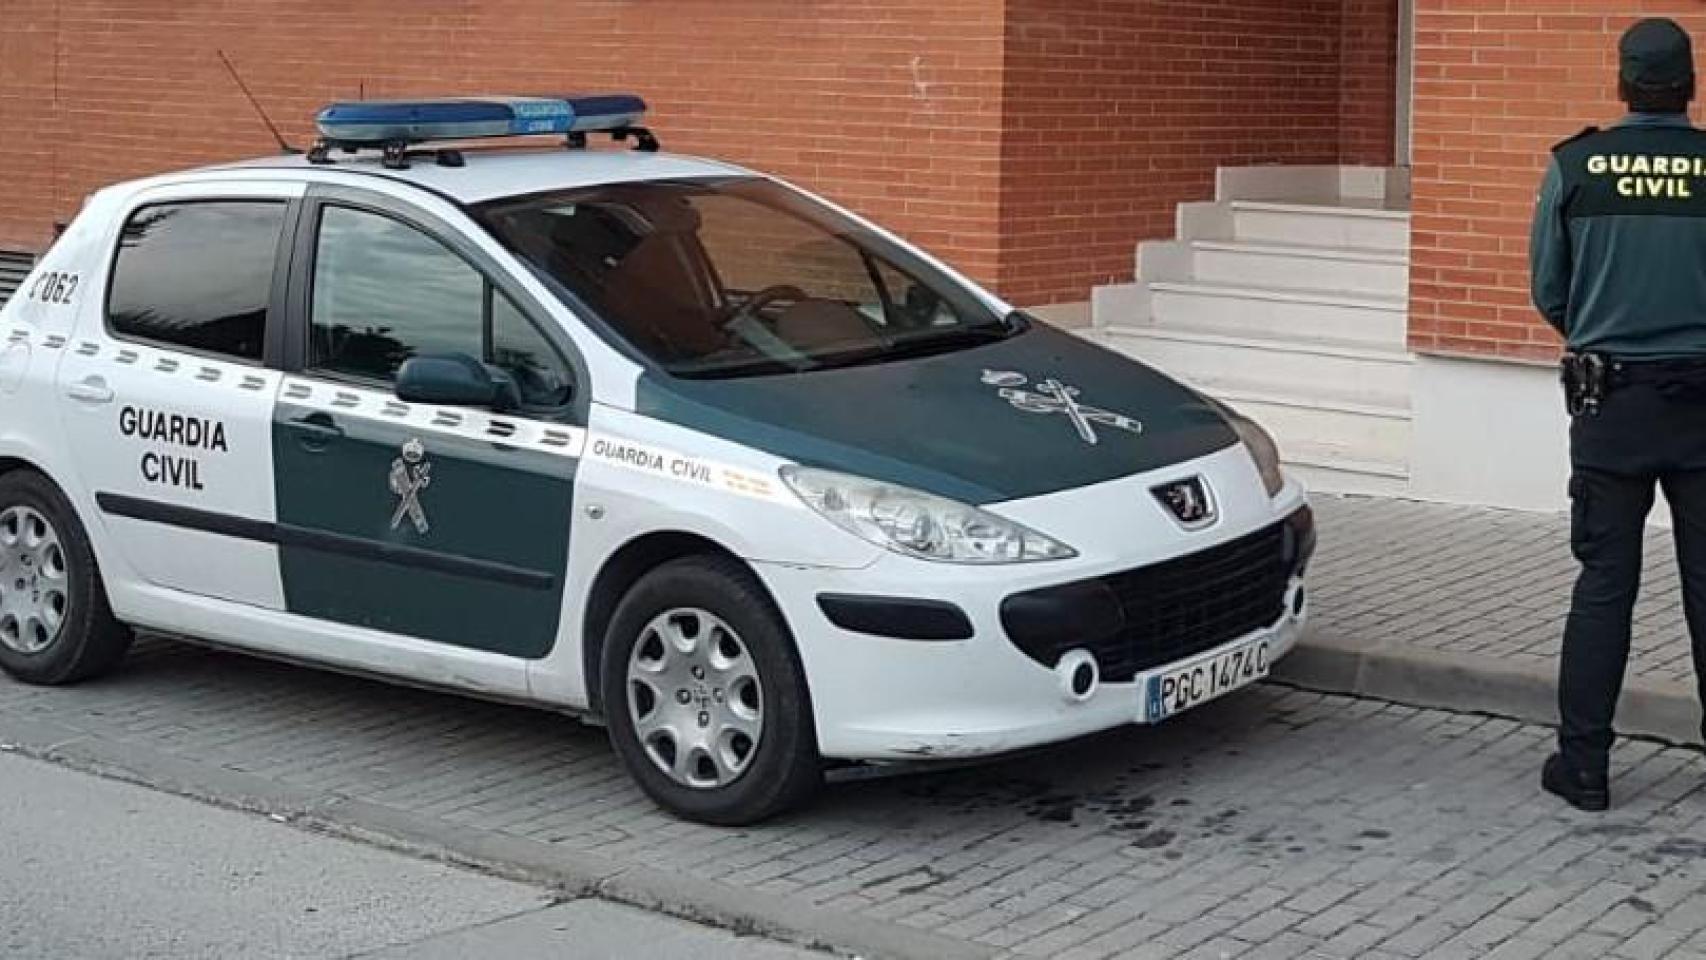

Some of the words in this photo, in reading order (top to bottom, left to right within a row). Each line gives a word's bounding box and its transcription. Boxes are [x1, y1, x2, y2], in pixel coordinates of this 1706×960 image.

[1587, 154, 1706, 176] GUARDI
[1617, 176, 1692, 198] CIVIL
[41, 271, 79, 304] 062
[119, 406, 228, 453] GUARDIA
[141, 452, 204, 490] CIVIL
[592, 440, 664, 471] GUARDIA
[671, 459, 712, 483] CIVIL
[1161, 667, 1204, 714] PGC
[1210, 647, 1253, 693] 1474
